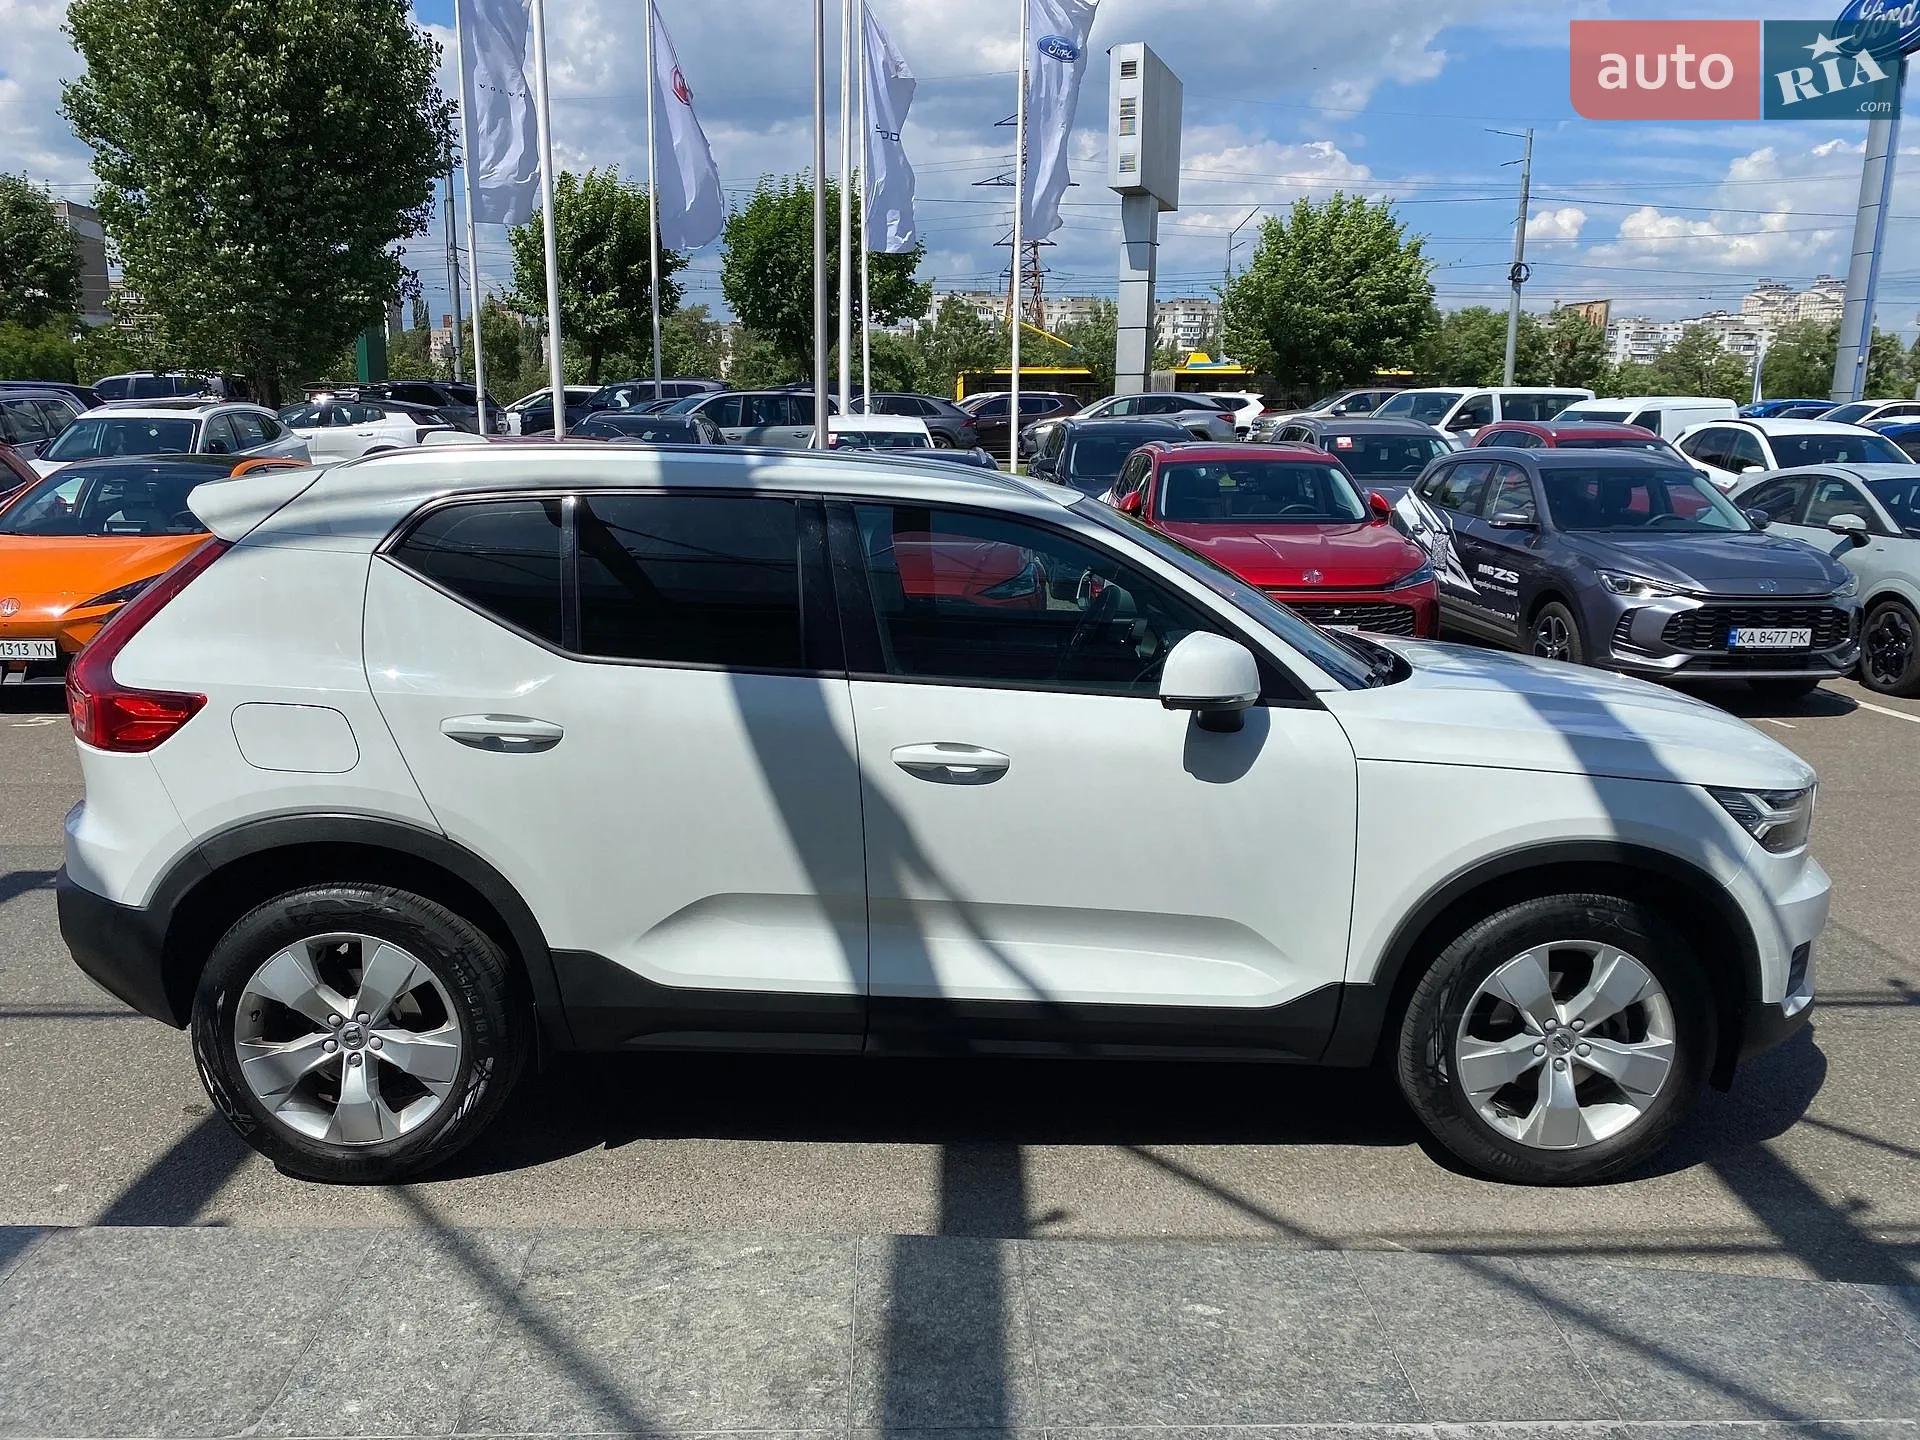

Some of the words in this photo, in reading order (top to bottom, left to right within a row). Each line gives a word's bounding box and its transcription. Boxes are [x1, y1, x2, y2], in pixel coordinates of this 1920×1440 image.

[1048, 39, 1073, 58] Ford
[479, 84, 525, 97] VOLVO
[1737, 631, 1756, 643] KA
[1759, 631, 1788, 643] 8477
[1790, 631, 1808, 643] PK
[0, 643, 29, 655] 1313
[34, 643, 55, 655] YN
